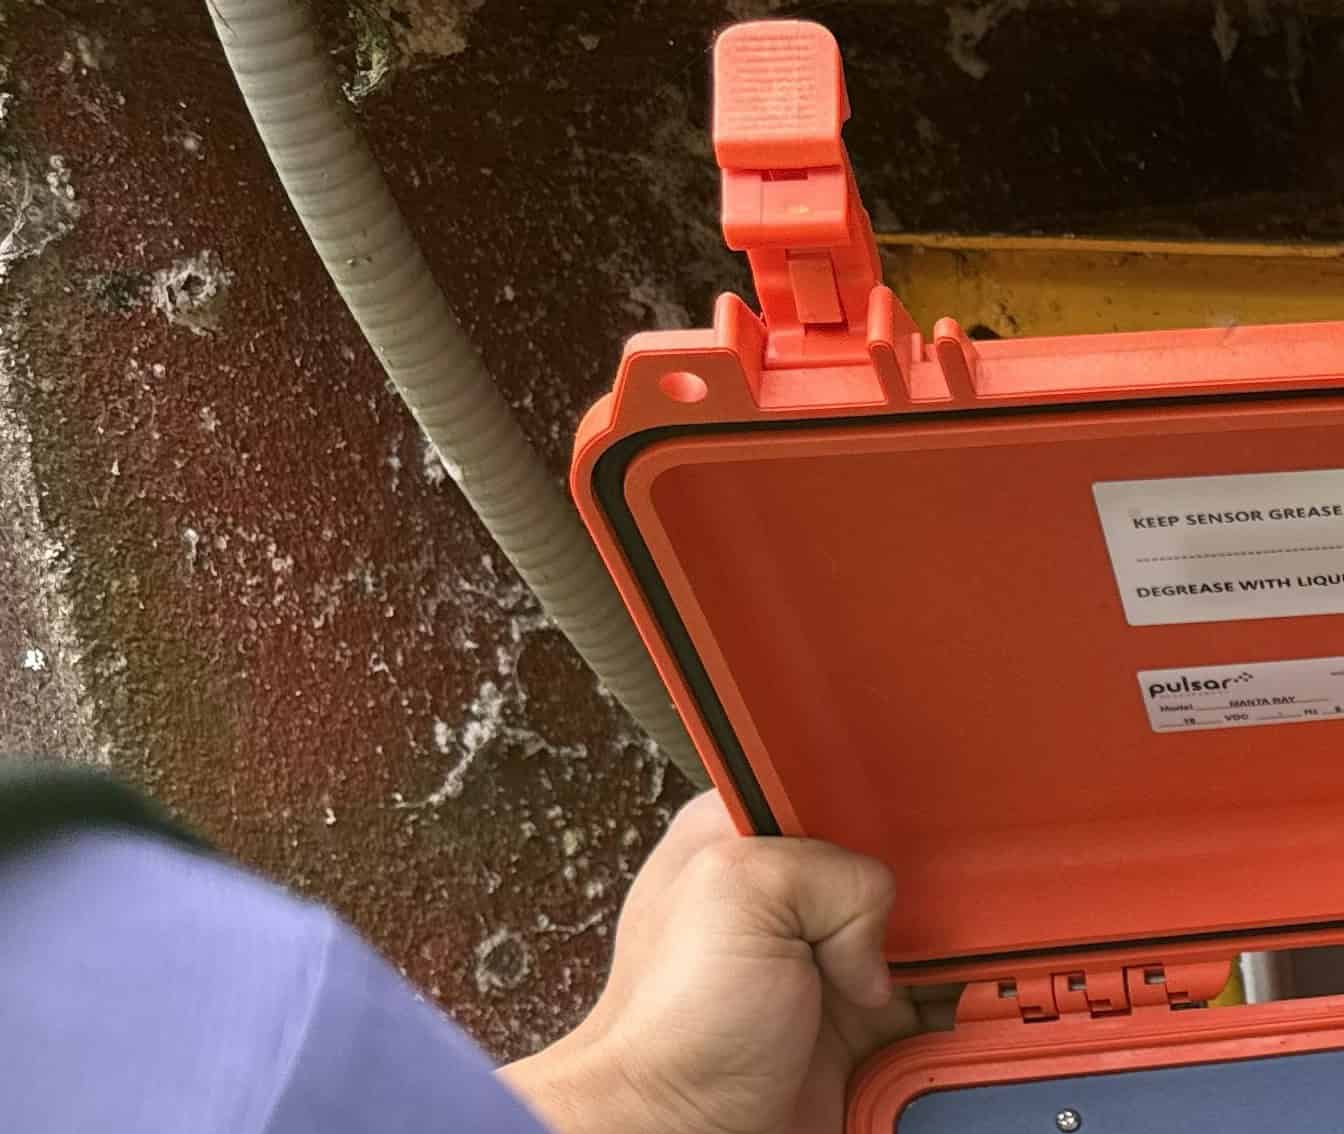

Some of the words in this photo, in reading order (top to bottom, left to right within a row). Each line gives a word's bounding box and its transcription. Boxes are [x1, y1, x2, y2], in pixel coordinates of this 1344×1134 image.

[1132, 515, 1180, 530] KEEP
[1185, 509, 1263, 528] SENSOR
[1268, 504, 1344, 522] GREASE
[1135, 580, 1236, 599] DEGREASE
[1238, 576, 1292, 593] WITH
[1148, 675, 1232, 699] pulsar
